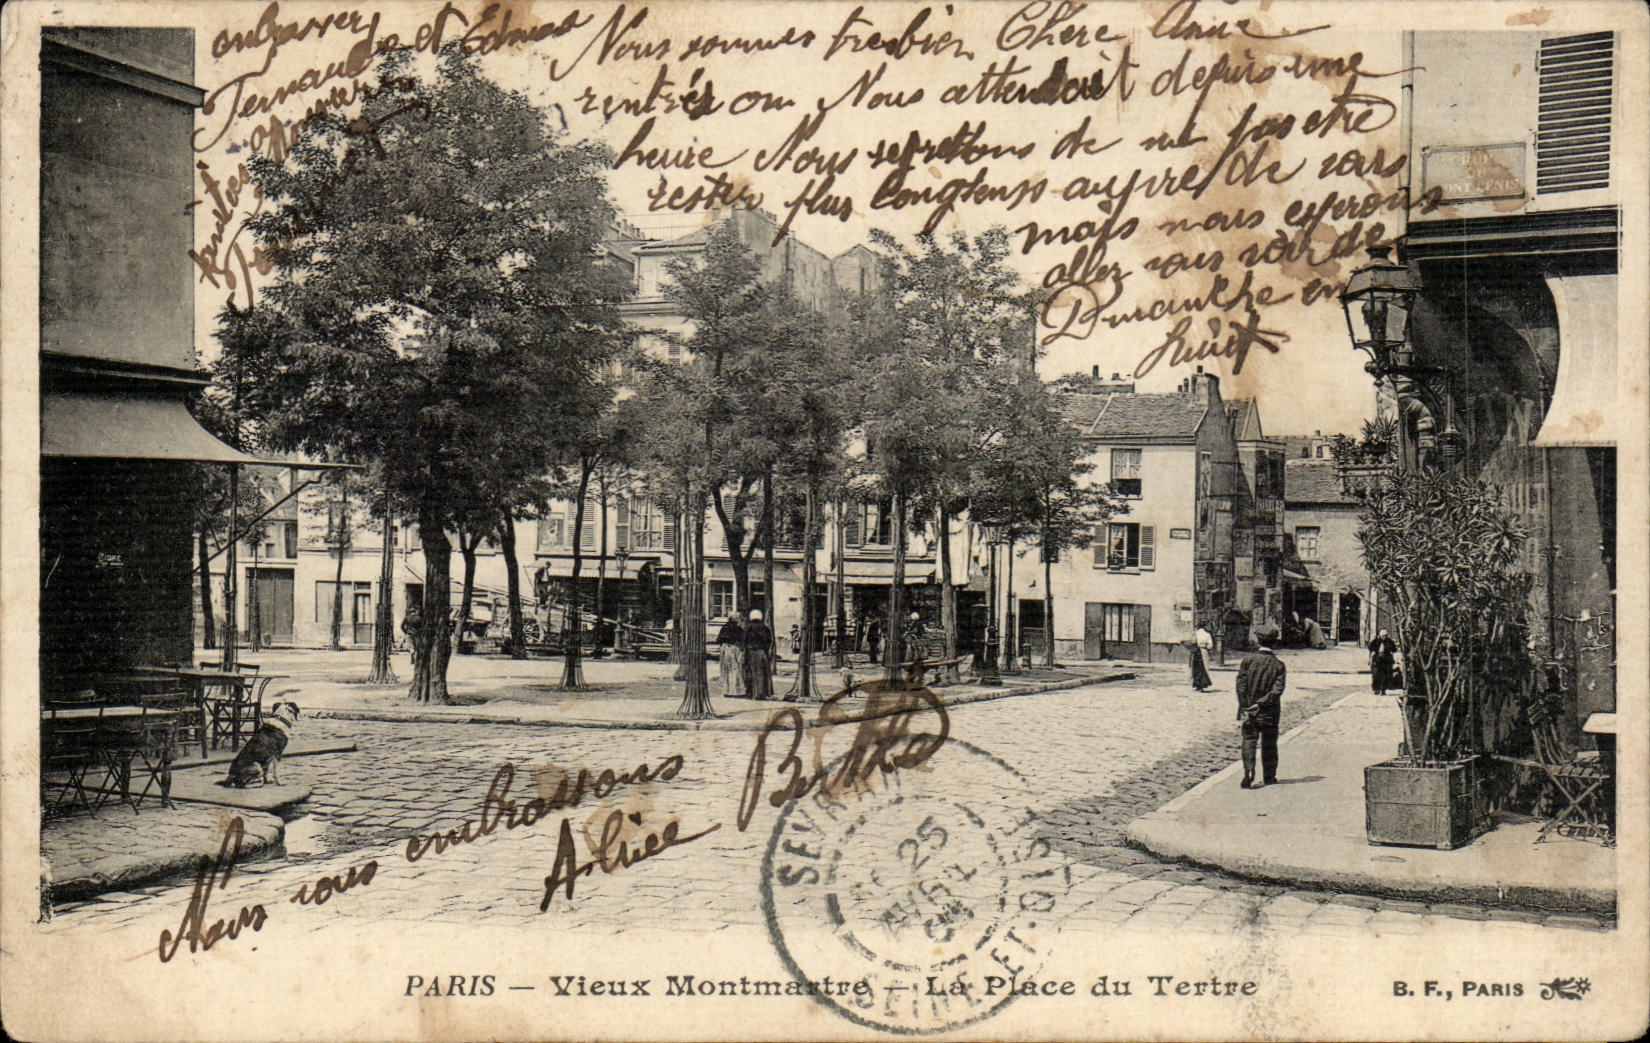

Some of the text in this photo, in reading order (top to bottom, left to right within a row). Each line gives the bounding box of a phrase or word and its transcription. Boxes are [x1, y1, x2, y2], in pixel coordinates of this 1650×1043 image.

[550, 4, 672, 81] Nous
[679, 27, 816, 61] sommes
[818, 62, 925, 112] Nous
[612, 117, 749, 170] heure
[755, 112, 858, 175] Nous
[1050, 116, 1123, 159] de
[773, 174, 853, 247] plus
[1226, 141, 1306, 187] de
[1318, 149, 1408, 180] vous
[1014, 200, 1140, 254] mais
[1158, 205, 1266, 236] nous
[1143, 252, 1224, 280] vous
[159, 816, 268, 962] Nous
[290, 860, 379, 904] vous
